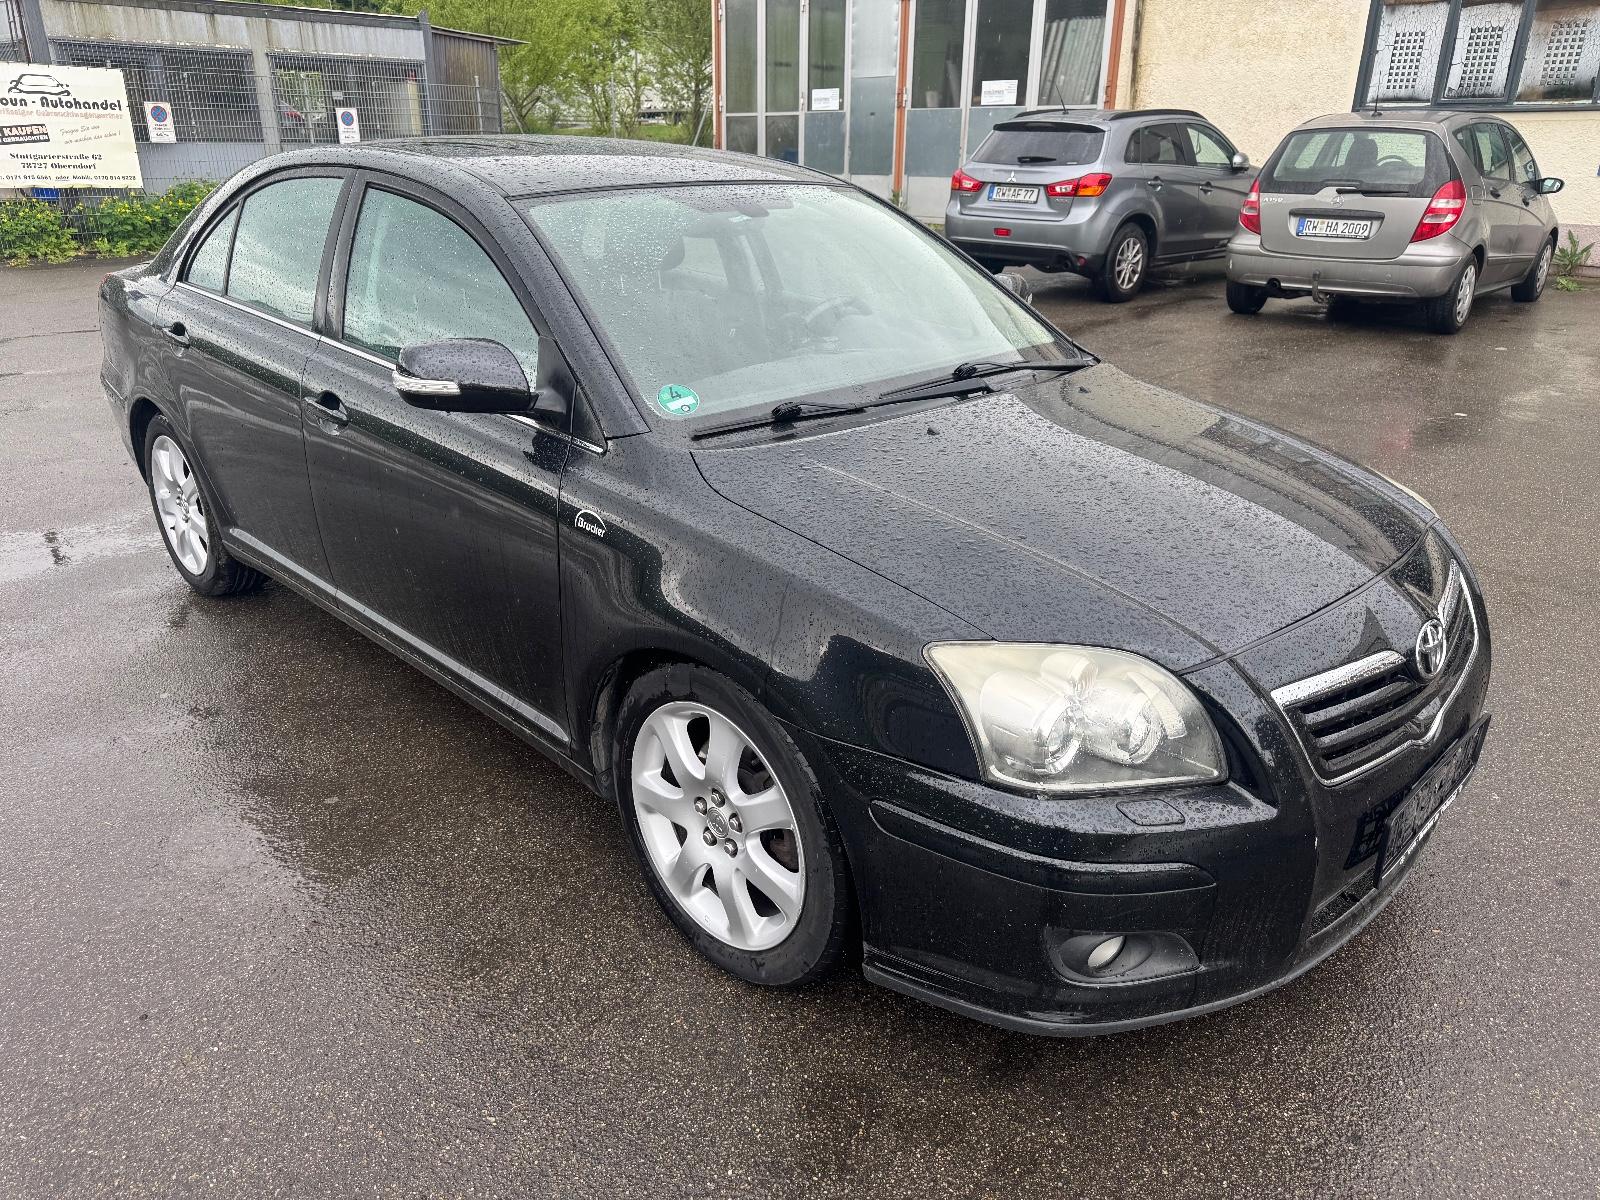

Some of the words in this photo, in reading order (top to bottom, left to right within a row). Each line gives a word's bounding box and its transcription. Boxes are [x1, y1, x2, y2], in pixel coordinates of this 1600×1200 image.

[40, 96, 122, 111] Autohandel
[2, 126, 48, 136] KAUFEN
[1023, 189, 1035, 200] 77
[1304, 220, 1319, 232] RW
[1325, 221, 1339, 234] HA
[1340, 222, 1369, 235] 2009
[669, 386, 682, 399] 4
